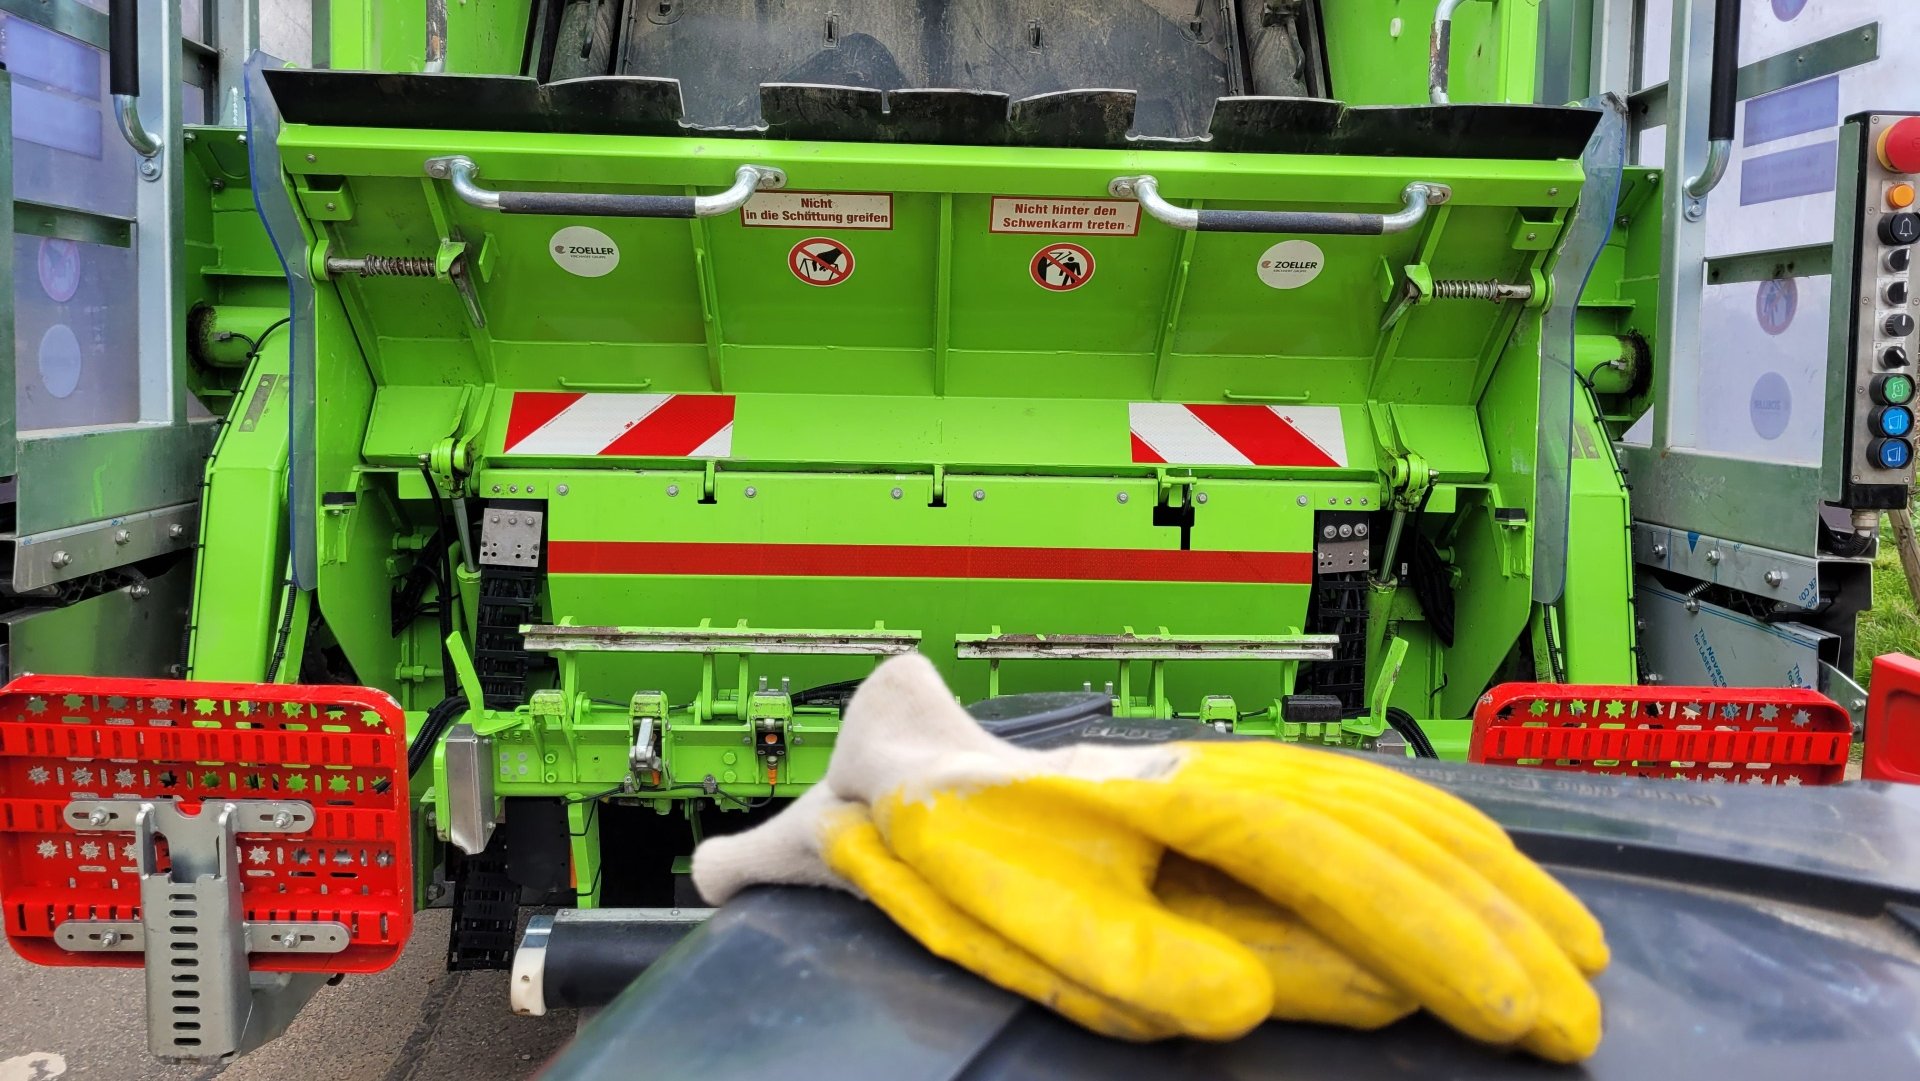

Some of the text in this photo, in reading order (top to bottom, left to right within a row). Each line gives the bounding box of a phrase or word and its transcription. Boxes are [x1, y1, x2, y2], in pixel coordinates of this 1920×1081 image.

[801, 198, 832, 209] Nicht
[1015, 203, 1117, 216] Nicht hinter den
[745, 210, 757, 220] in
[761, 210, 779, 220] die
[846, 212, 888, 224] greifen
[1003, 217, 1125, 230] Schwenkarm treten
[569, 246, 614, 255] ZOELLER
[1274, 261, 1318, 269] ZOELLER
[1698, 627, 1708, 646] The
[1693, 633, 1701, 647] for
[1698, 646, 1712, 673] LASER
